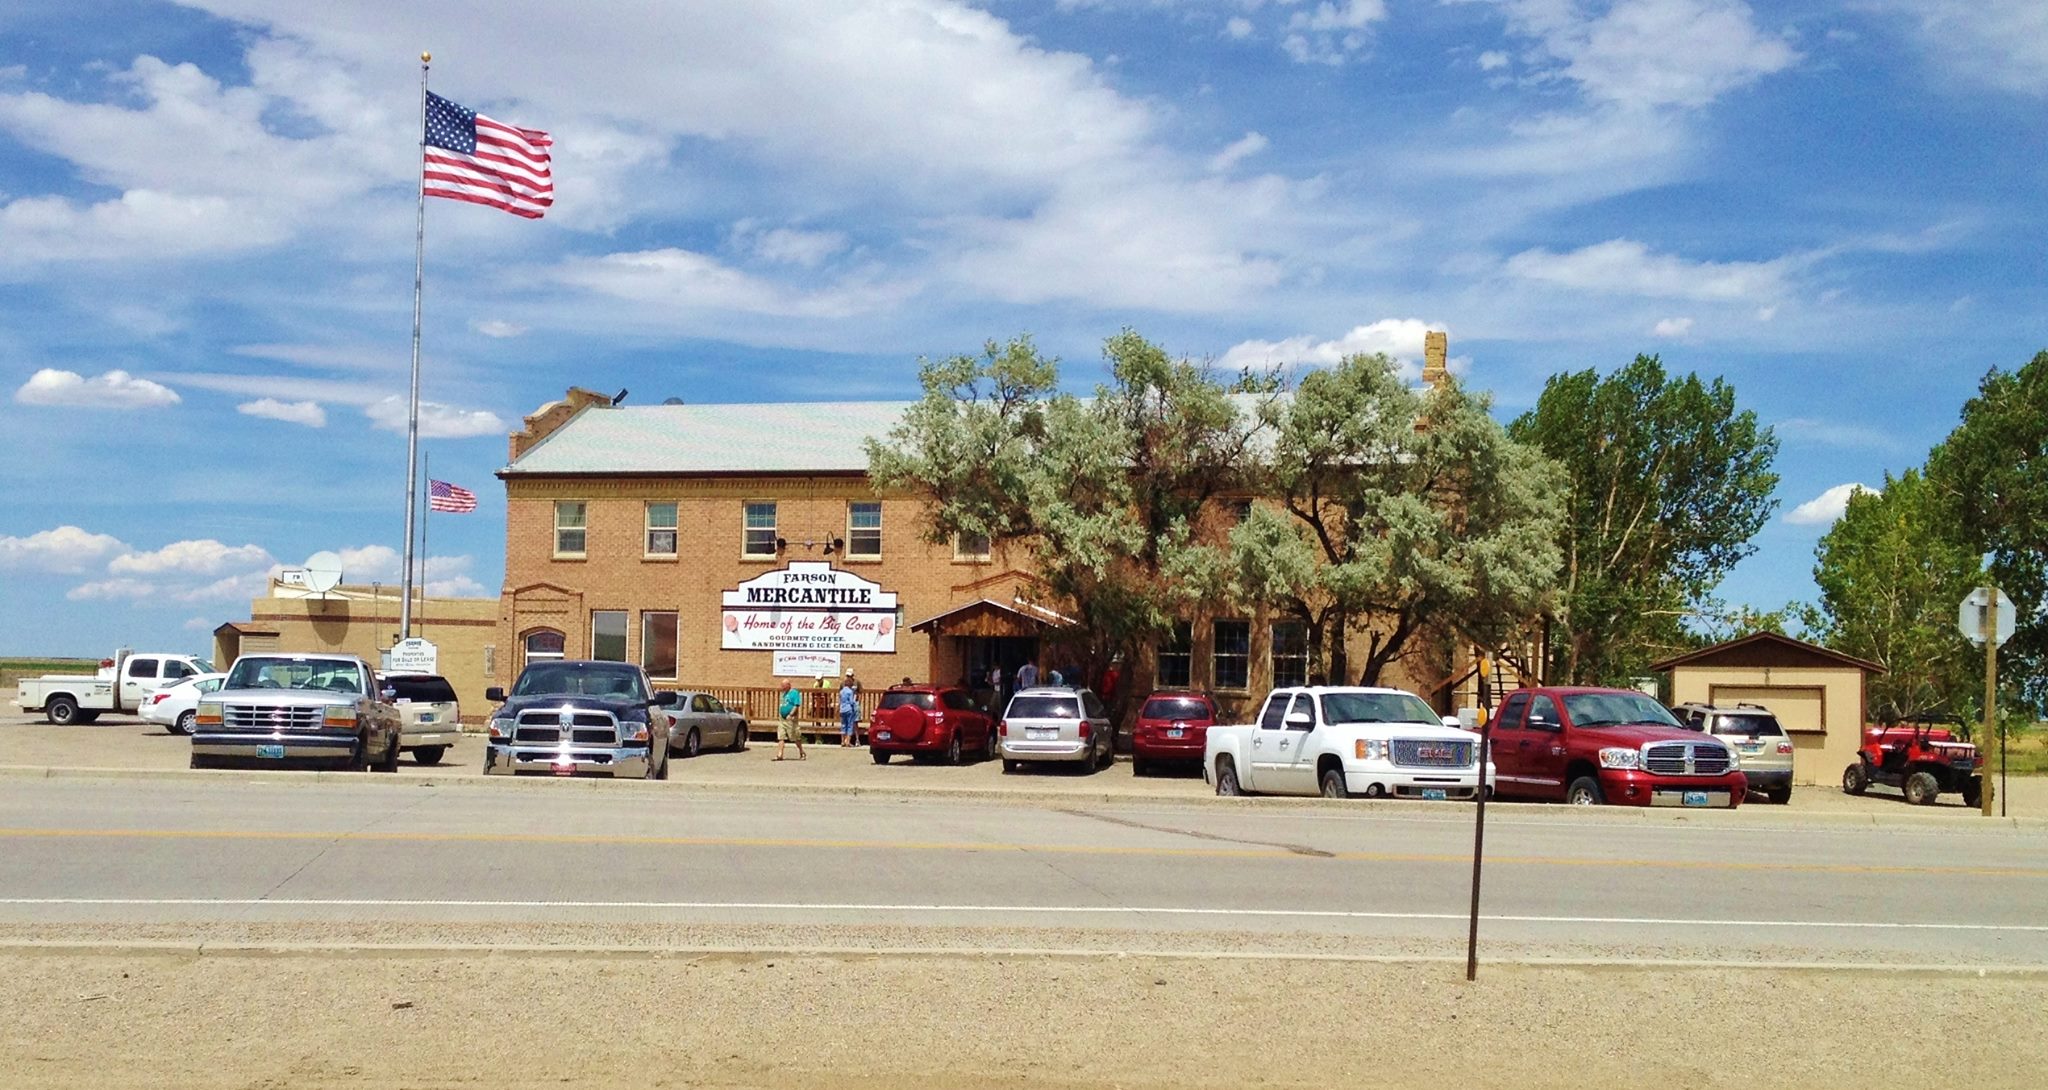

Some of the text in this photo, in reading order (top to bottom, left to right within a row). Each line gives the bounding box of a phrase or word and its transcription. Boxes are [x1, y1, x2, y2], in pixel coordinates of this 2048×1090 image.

[783, 573, 837, 584] FARSON
[747, 587, 871, 604] MERCANTILE
[743, 613, 875, 635] Home of the Big Cone
